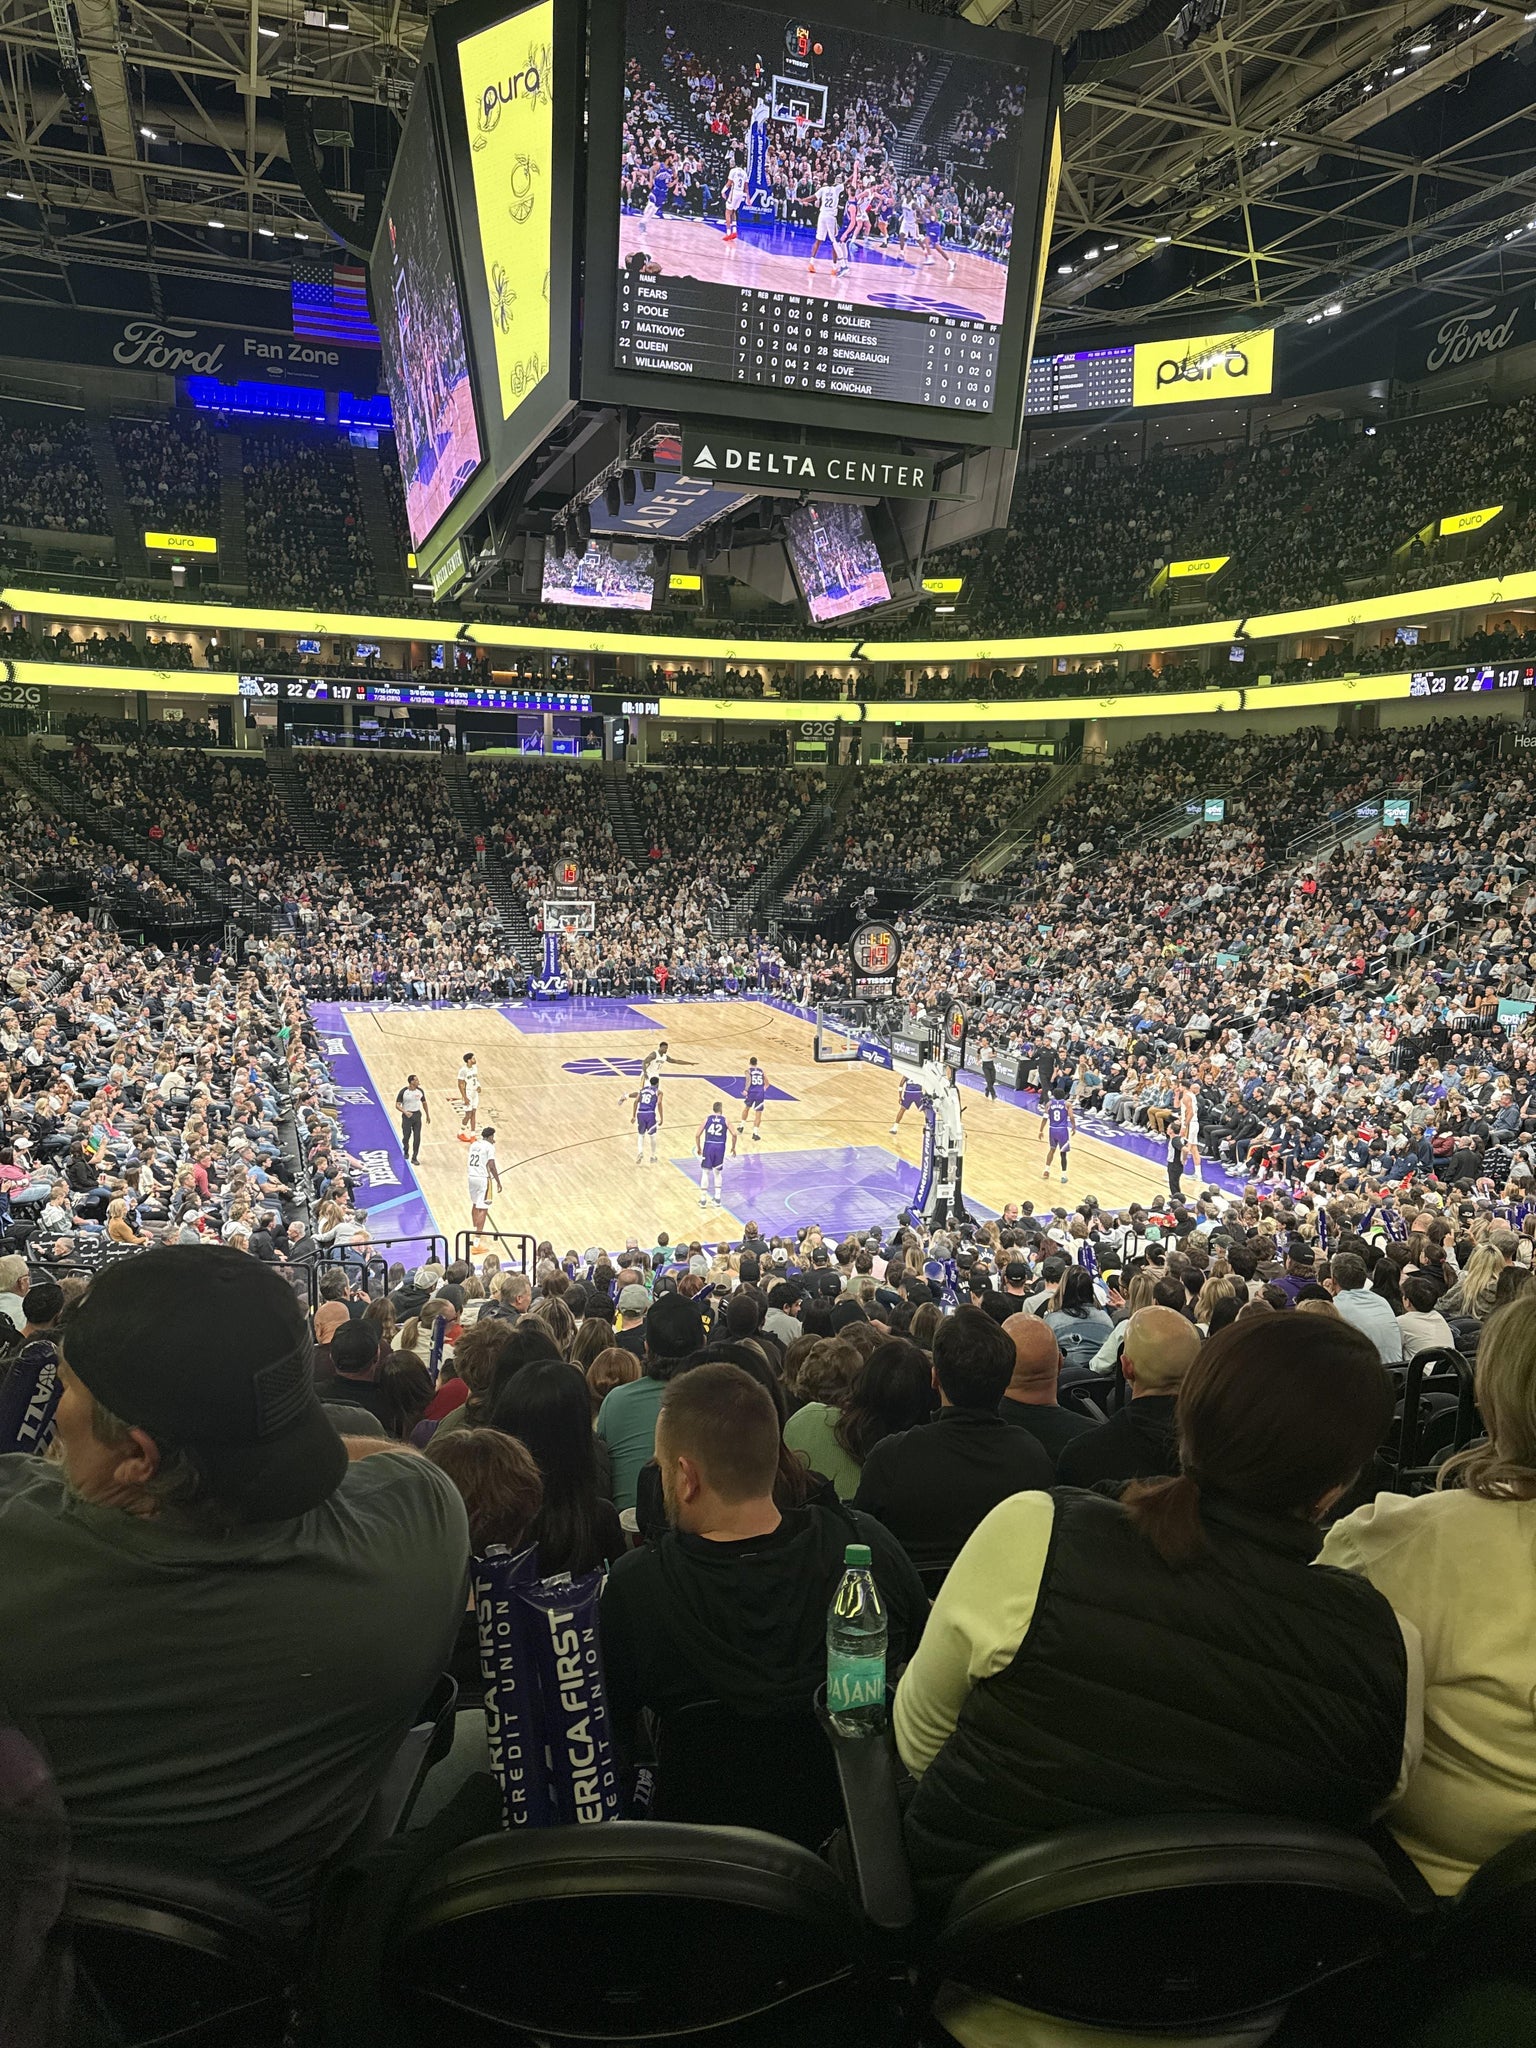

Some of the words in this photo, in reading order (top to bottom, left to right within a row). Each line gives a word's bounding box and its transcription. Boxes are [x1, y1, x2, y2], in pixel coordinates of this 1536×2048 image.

[484, 67, 540, 117] pura
[639, 275, 656, 283] NAME
[741, 289, 752, 297] PTS
[623, 285, 630, 294] 0
[638, 288, 668, 300] FEARS
[742, 303, 748, 311] 2
[759, 305, 766, 313] 4
[775, 307, 780, 316] 0
[788, 309, 800, 319] 02
[806, 311, 812, 320] 0
[838, 303, 853, 311] NAME
[929, 316, 939, 324] PTS
[945, 318, 956, 326] REB
[623, 303, 629, 312] 3
[637, 305, 669, 318] POOLE
[741, 320, 747, 328] 0
[759, 322, 764, 330] 1
[773, 324, 779, 333] 0
[787, 326, 798, 335] 04
[805, 328, 811, 337] 0
[822, 313, 828, 322] 8
[835, 316, 871, 328] COLLIER
[930, 329, 936, 337] 0
[946, 331, 952, 339] 0
[960, 333, 966, 341] 0
[972, 335, 982, 343] 02
[989, 337, 995, 345] 0
[113, 322, 225, 374] Ford
[621, 320, 630, 329] 17
[637, 322, 685, 337] MATKOVIC
[740, 336, 746, 345] 0
[757, 339, 763, 347] 0
[772, 341, 778, 349] 2
[786, 342, 797, 352] 04
[804, 345, 810, 353] 0
[819, 330, 828, 339] 16
[834, 332, 878, 345] HARKLESS
[928, 345, 934, 353] 2
[944, 347, 950, 355] 0
[960, 349, 965, 358] 1
[970, 351, 981, 360] 04
[988, 353, 993, 361] 1
[1427, 305, 1519, 371] Ford
[244, 339, 283, 359] Fan
[288, 344, 339, 365] Zone
[619, 338, 630, 347] 22
[636, 340, 668, 352] QUEEN
[739, 353, 745, 362] 7
[756, 356, 762, 364] 0
[771, 358, 777, 366] 0
[785, 359, 796, 368] 04
[803, 362, 809, 370] 2
[818, 347, 828, 356] 28
[833, 349, 890, 364] SENSABAUGH
[927, 362, 933, 370] 2
[944, 364, 948, 372] 1
[958, 365, 963, 374] 0
[969, 367, 979, 376] 02
[985, 369, 992, 377] 0
[622, 355, 627, 363] 1
[635, 357, 693, 372] WILLIAMSON
[738, 370, 744, 378] 2
[756, 372, 761, 380] 1
[771, 374, 776, 382] 1
[784, 376, 795, 385] 07
[802, 378, 808, 387] 0
[816, 363, 827, 372] 42
[832, 365, 854, 376] LOVE
[925, 377, 931, 386] 3
[942, 380, 948, 388] 0
[967, 382, 978, 391] 03
[984, 385, 990, 393] 0
[815, 380, 826, 388] 55
[831, 381, 872, 394] KONCHAR
[924, 393, 930, 401] 3
[940, 395, 946, 403] 0
[955, 397, 960, 405] 0
[966, 398, 976, 408] 04
[982, 400, 988, 408] 0
[726, 449, 816, 477] DELTA
[827, 459, 924, 487] CENTER
[1459, 515, 1482, 528] pura
[168, 537, 194, 546] pura
[1188, 562, 1210, 572] pura
[0, 685, 40, 703] G2G
[263, 683, 278, 695] 23
[287, 684, 303, 696] 22
[332, 686, 351, 700] 1:17
[1432, 678, 1446, 692] 23
[1454, 675, 1469, 691] 22
[1499, 670, 1519, 687] 1:17
[645, 703, 658, 714] PM
[801, 722, 835, 736] G2G
[340, 1004, 432, 1013] UTAH
[441, 1002, 528, 1010] JAZZ
[752, 1075, 763, 1085] 55
[641, 1094, 651, 1104] 16
[707, 1123, 723, 1136] 42
[1053, 1110, 1061, 1121] 8
[469, 1154, 480, 1167] 22
[917, 1156, 929, 1202] AMERICA
[476, 1576, 497, 1679] FIRST
[497, 1600, 515, 1692] UNION
[548, 1608, 589, 1712] FIRST
[582, 1628, 606, 1721] UNION
[504, 1712, 527, 1824] CREDIT
[566, 1716, 603, 1824] ERICA
[598, 1740, 620, 1823] REDIT
